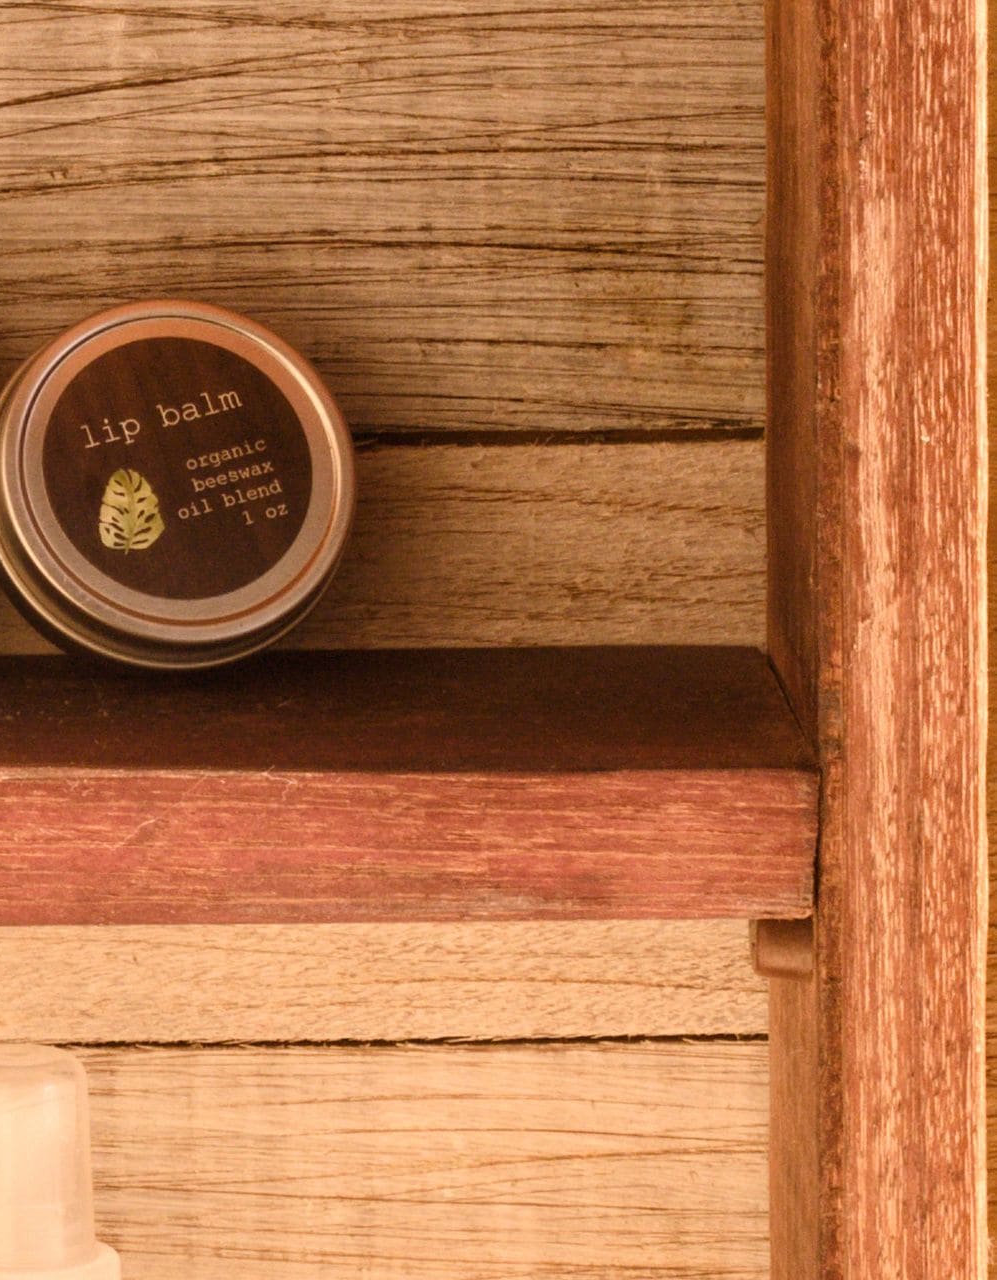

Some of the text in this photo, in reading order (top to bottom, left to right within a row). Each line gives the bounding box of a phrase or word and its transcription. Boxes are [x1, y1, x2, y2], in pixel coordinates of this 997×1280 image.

[80, 389, 243, 449] lip balm
[186, 437, 267, 470] organic
[191, 460, 275, 493] beeswax
[178, 480, 283, 521] oil blend
[242, 502, 289, 525] 1 oz
